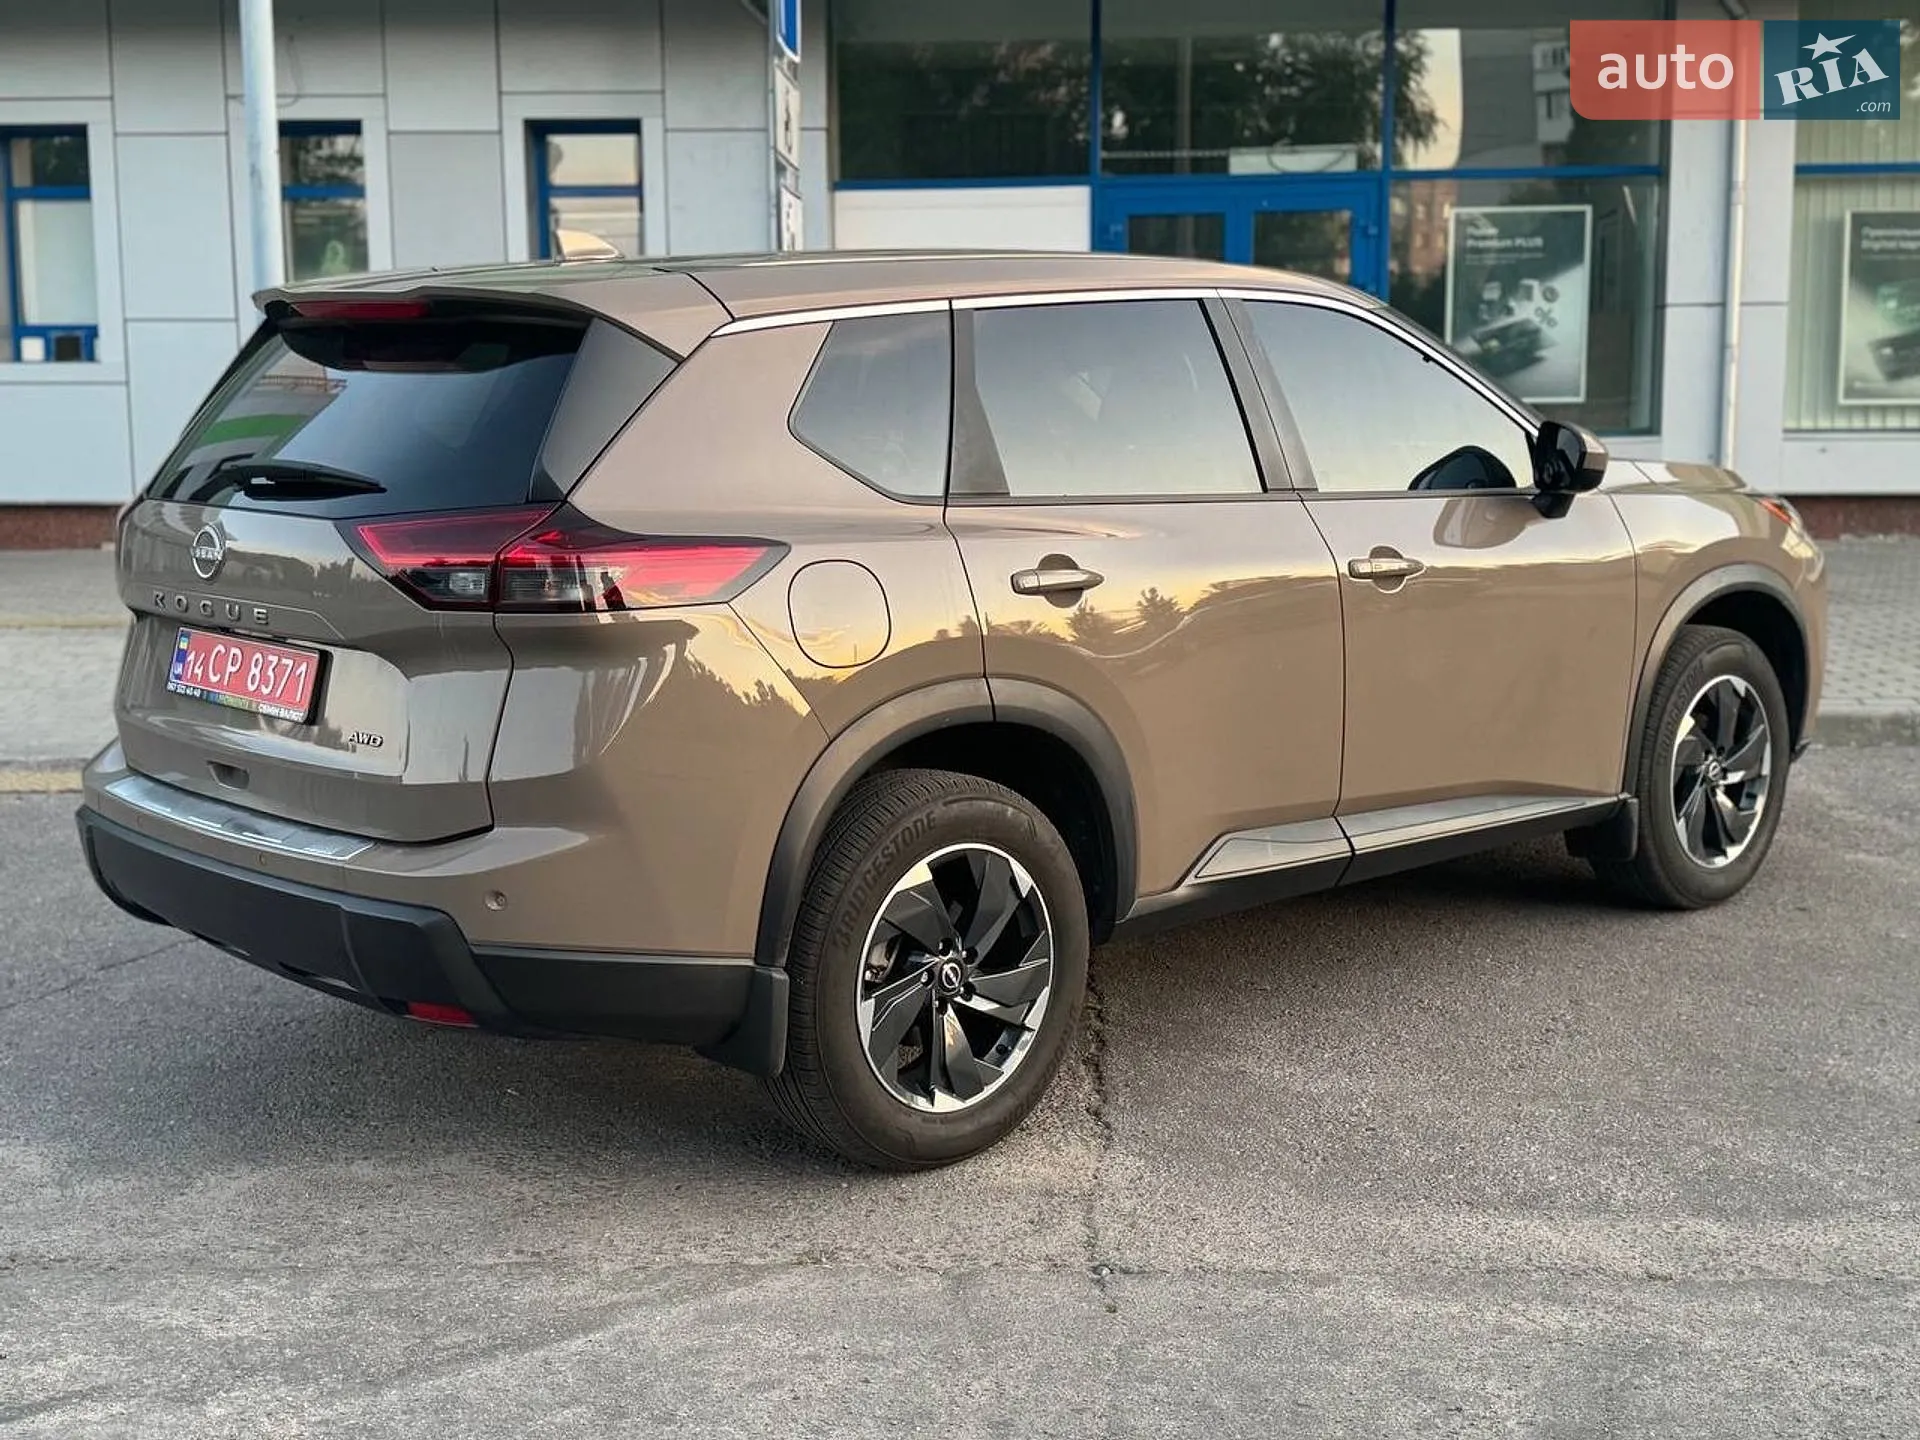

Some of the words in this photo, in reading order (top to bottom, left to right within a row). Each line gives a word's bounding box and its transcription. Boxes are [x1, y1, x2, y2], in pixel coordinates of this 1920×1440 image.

[153, 591, 269, 625] ROGUE
[186, 651, 205, 682] 14
[247, 652, 308, 703] 8371
[349, 732, 383, 748] AWD
[832, 810, 937, 948] BRIDGESTONE
